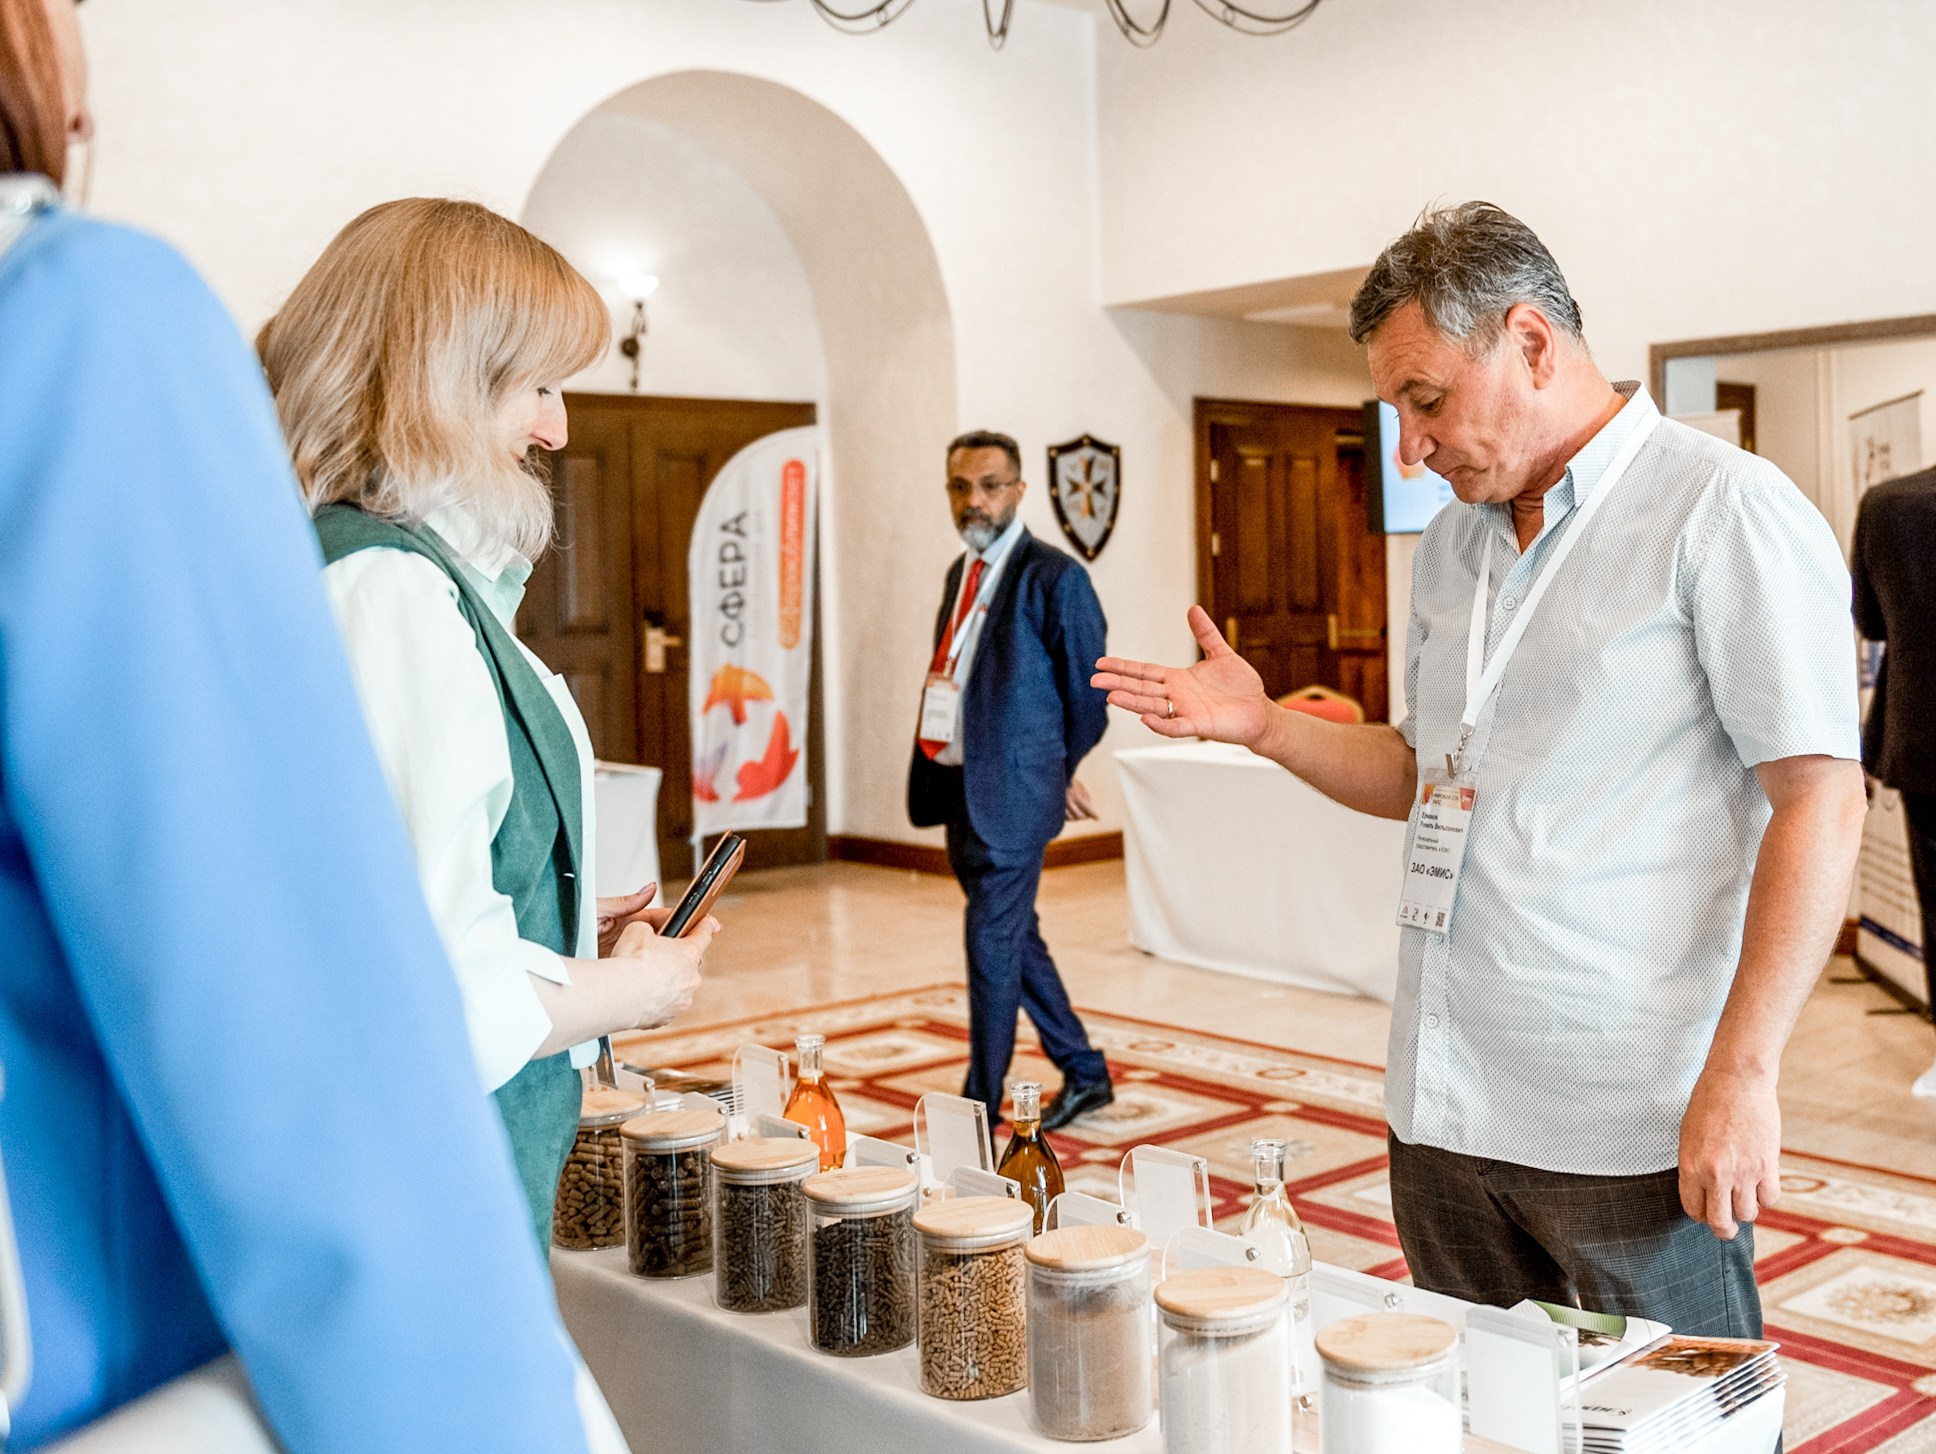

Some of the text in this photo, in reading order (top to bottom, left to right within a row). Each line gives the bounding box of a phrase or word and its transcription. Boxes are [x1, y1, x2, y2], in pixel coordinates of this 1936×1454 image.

[719, 511, 747, 648] СФЕРА
[1410, 862, 1453, 880] ЗАО «ЭМИС»
